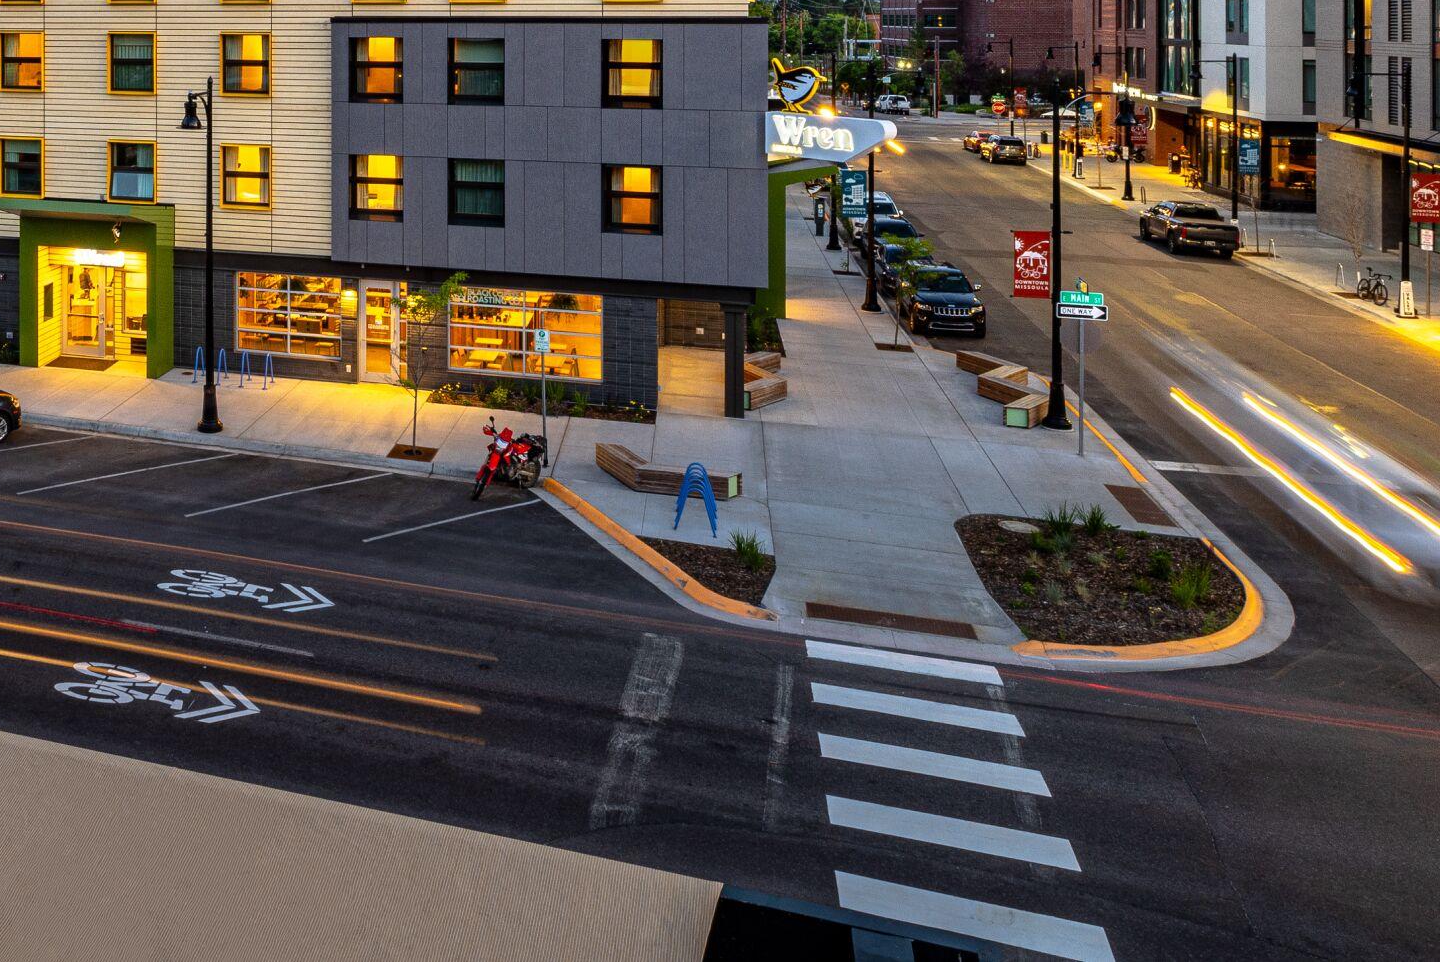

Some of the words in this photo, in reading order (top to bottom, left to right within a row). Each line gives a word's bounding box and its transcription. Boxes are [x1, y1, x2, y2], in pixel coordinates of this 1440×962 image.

[772, 115, 854, 152] Wren
[468, 288, 491, 297] BLACK
[468, 295, 506, 305] ROASTING
[1070, 293, 1090, 303] MAIN
[1061, 307, 1076, 315] ONE
